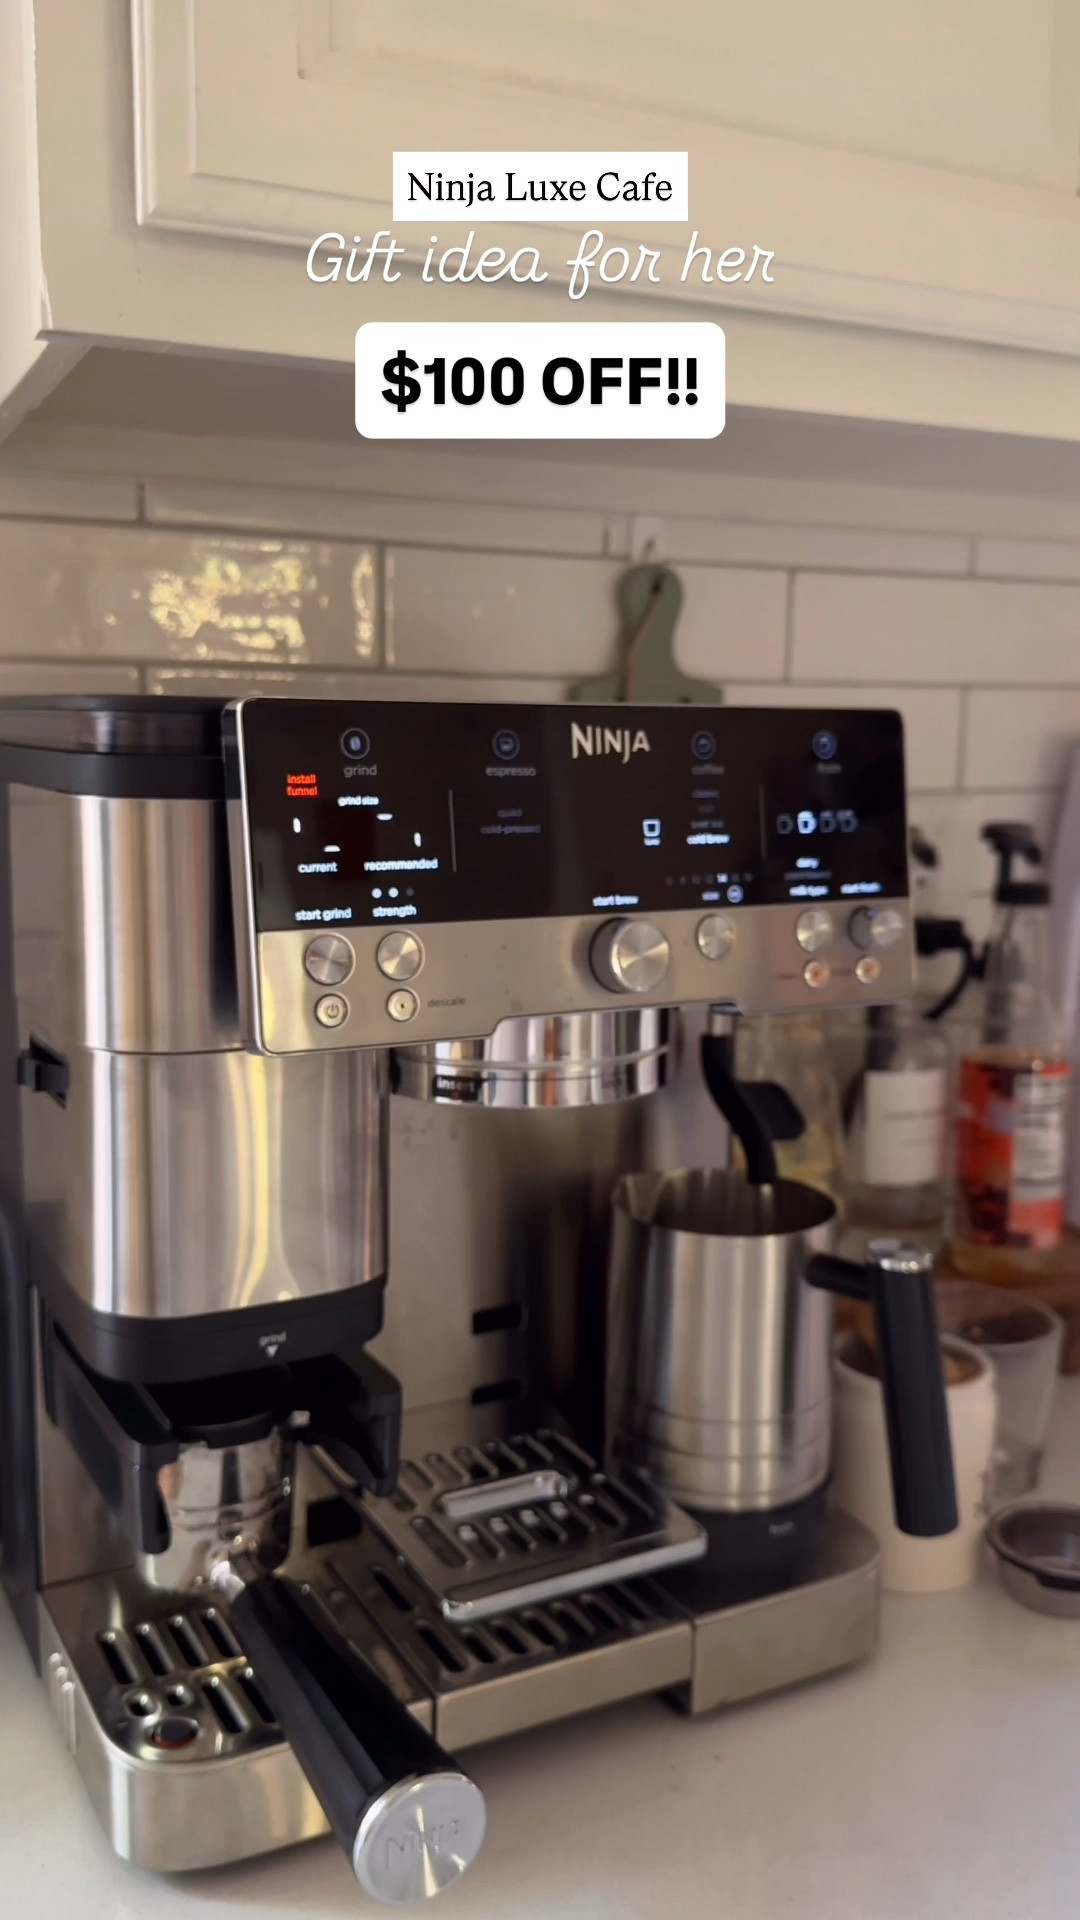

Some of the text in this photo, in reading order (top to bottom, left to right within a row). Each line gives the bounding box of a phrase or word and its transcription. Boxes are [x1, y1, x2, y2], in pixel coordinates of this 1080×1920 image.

[570, 721, 651, 765] NINJA
[343, 763, 378, 778] grind
[485, 765, 537, 778] espresso
[286, 773, 317, 785] install
[286, 785, 318, 797] funnel
[337, 795, 380, 807] grind size
[297, 861, 338, 874] current
[363, 858, 439, 872] recommended
[294, 907, 352, 921] start grind
[372, 904, 417, 918] strength
[436, 1075, 476, 1093] insert
